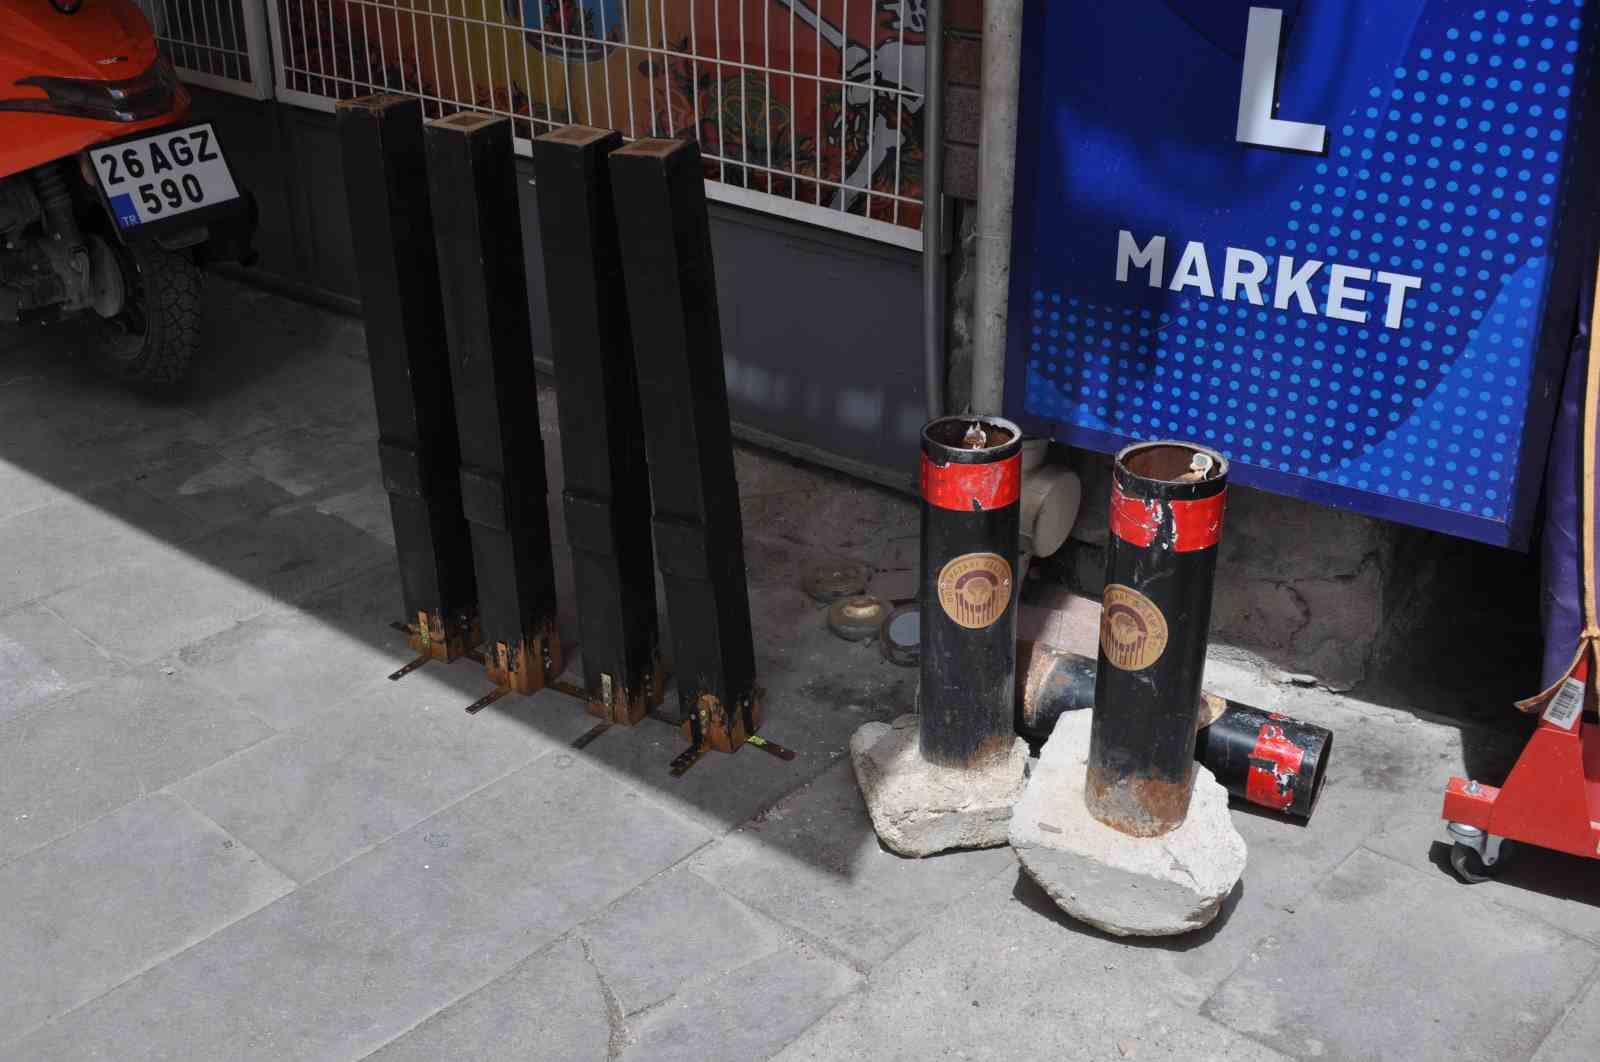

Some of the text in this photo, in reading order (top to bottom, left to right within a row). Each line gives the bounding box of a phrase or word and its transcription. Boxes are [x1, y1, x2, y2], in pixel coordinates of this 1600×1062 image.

[1236, 6, 1326, 153] L
[100, 130, 218, 185] 26 AGZ
[121, 215, 137, 226] TR
[139, 174, 204, 214] 590
[1115, 230, 1422, 330] MARKET
